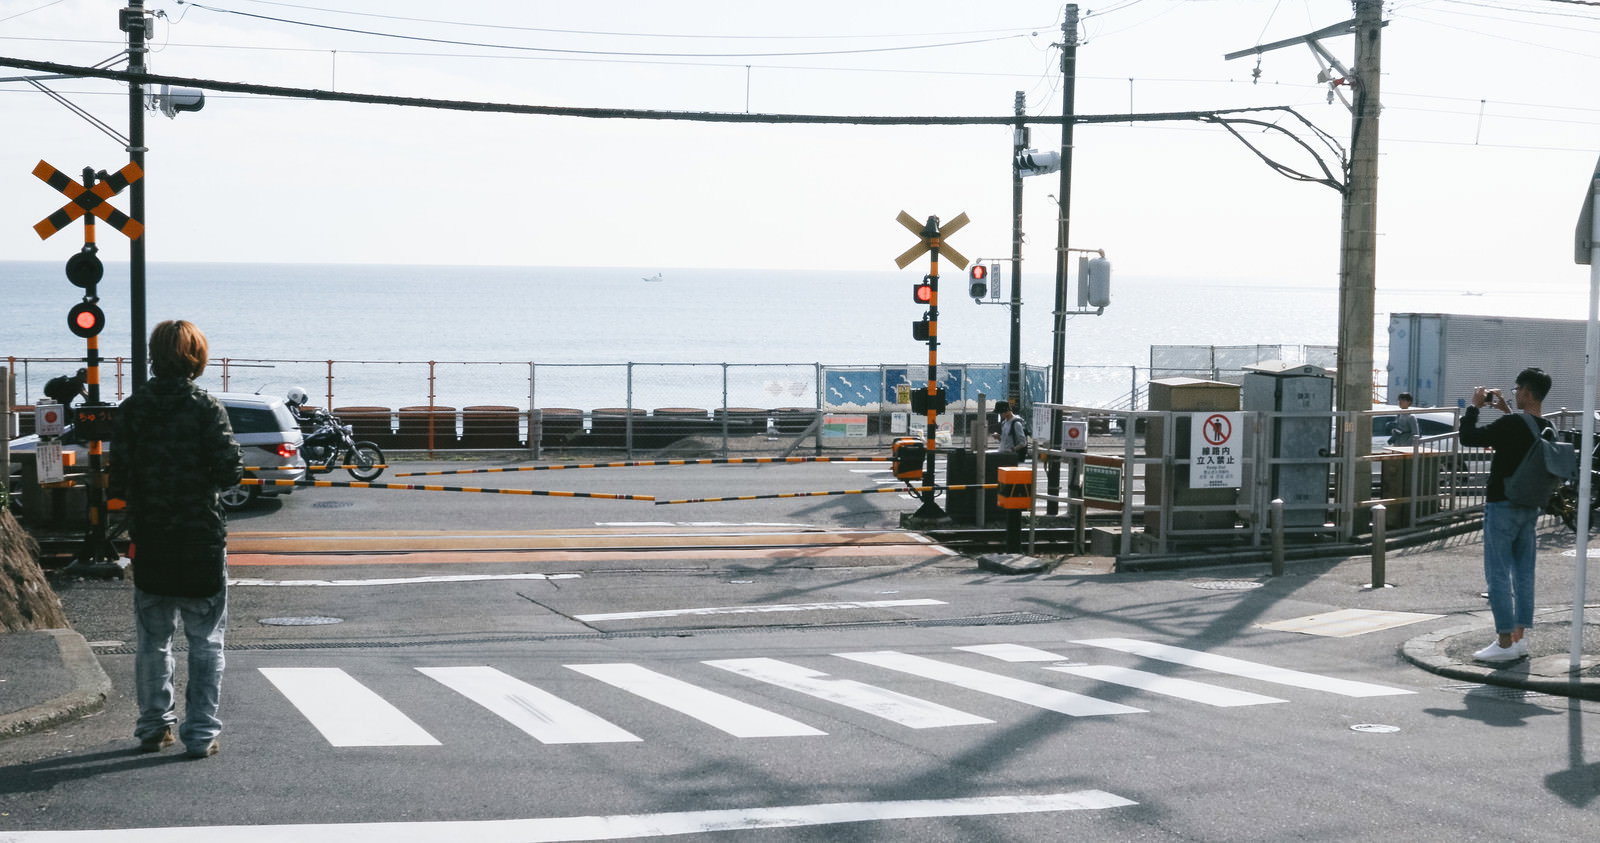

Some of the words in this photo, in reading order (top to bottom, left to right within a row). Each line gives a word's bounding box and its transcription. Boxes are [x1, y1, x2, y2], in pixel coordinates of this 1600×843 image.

[1202, 447, 1230, 455] 線路内
[1197, 456, 1234, 464] 立入禁止
